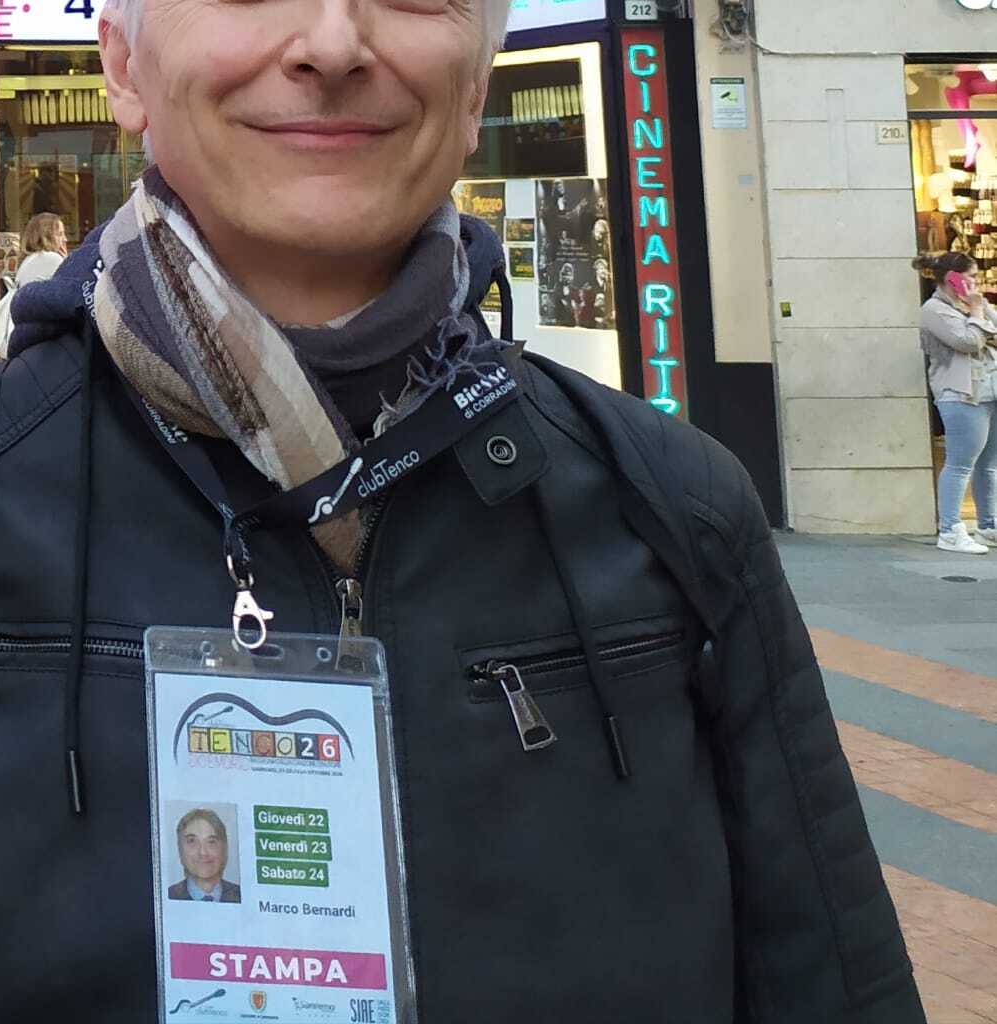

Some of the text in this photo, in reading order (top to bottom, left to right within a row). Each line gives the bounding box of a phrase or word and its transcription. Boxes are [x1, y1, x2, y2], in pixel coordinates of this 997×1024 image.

[631, 4, 653, 17] 212
[627, 44, 670, 266] CINEMA
[308, 814, 325, 827] 22
[311, 841, 328, 854] 23
[261, 865, 325, 881] Sabato 24
[258, 900, 356, 918] Marco Bernardi
[209, 951, 349, 984] STAMPA
